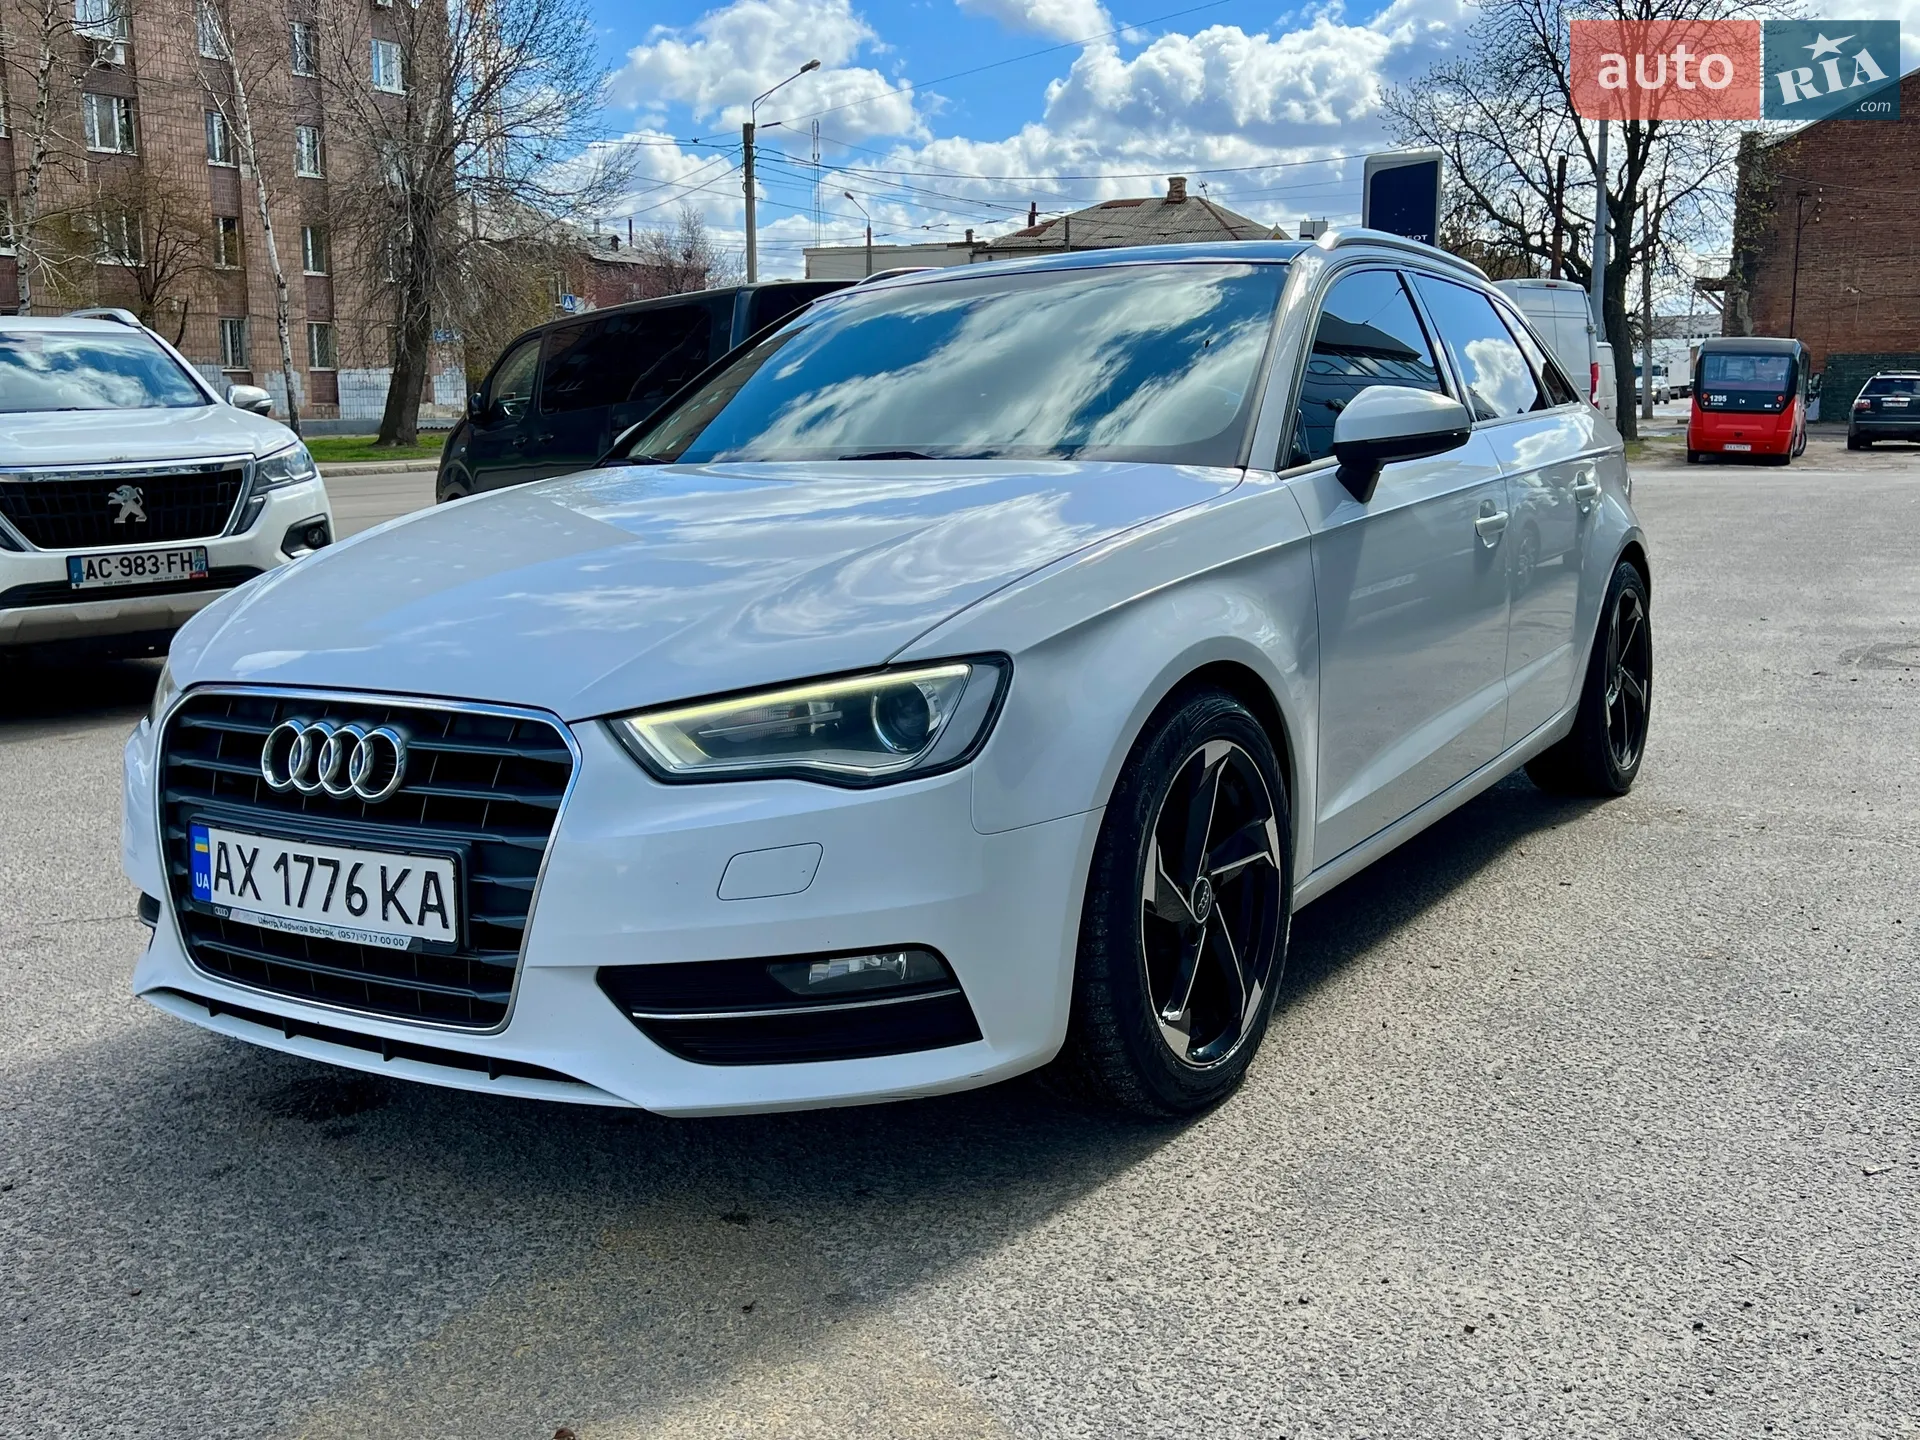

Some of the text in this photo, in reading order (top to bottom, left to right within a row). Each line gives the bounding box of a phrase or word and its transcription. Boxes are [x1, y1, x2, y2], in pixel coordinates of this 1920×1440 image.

[195, 871, 210, 890] UA
[213, 841, 450, 930] AX 1776 KA
[279, 919, 309, 933] Харьков
[309, 925, 335, 937] Восток
[380, 936, 391, 945] 00
[393, 938, 404, 947] 00
